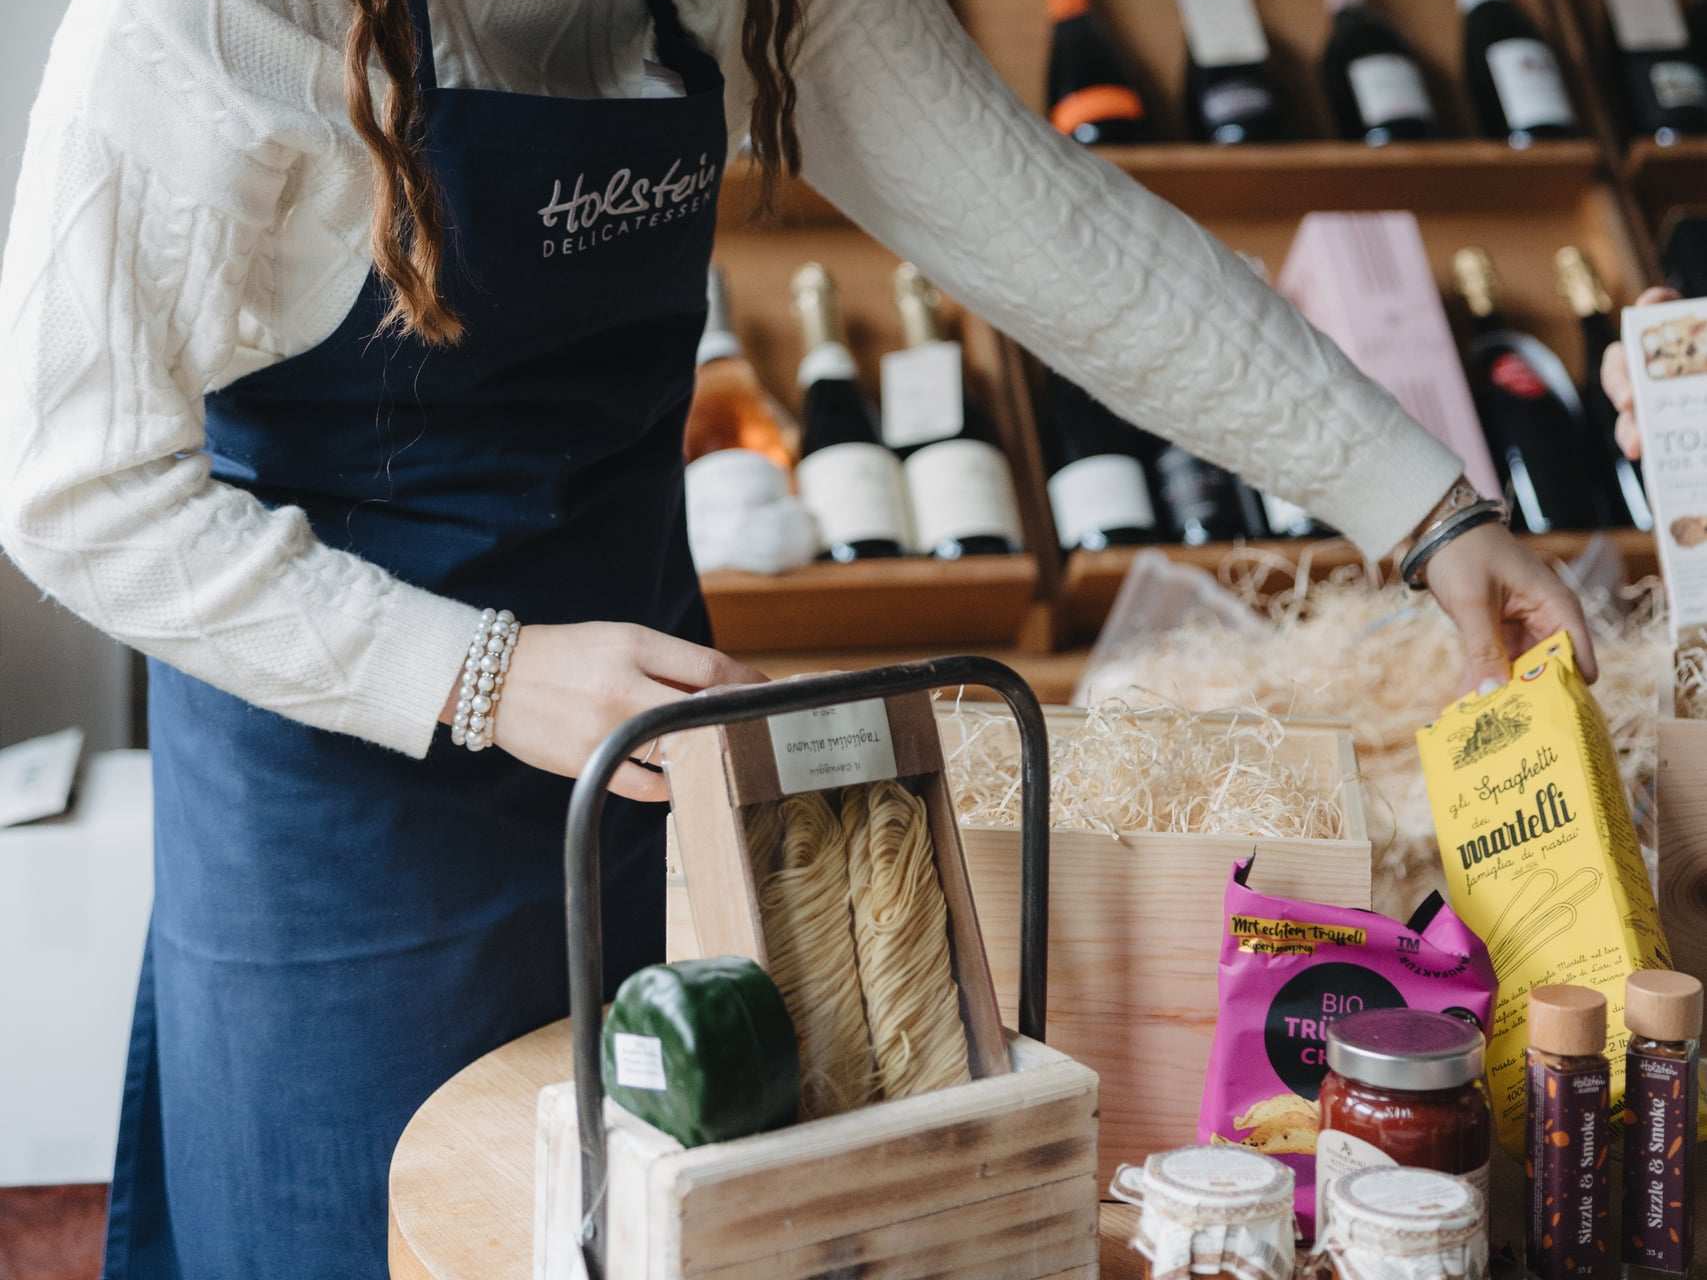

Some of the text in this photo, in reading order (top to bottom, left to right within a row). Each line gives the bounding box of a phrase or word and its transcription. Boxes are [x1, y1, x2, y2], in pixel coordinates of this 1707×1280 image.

[538, 152, 715, 233] Holstein
[1473, 745, 1559, 805] Spaghetti
[1456, 782, 1577, 870] martelli
[1466, 855, 1515, 896] famiglia
[1231, 917, 1259, 935] Mit
[1262, 922, 1307, 940] echtem
[1396, 935, 1420, 954] TM
[1322, 992, 1364, 1014] BIO
[1649, 1097, 1665, 1153] Smoke
[1579, 1112, 1595, 1245] Sizzle & Smoke
[1648, 1159, 1665, 1175] &
[1647, 1180, 1664, 1229] Sizzle
